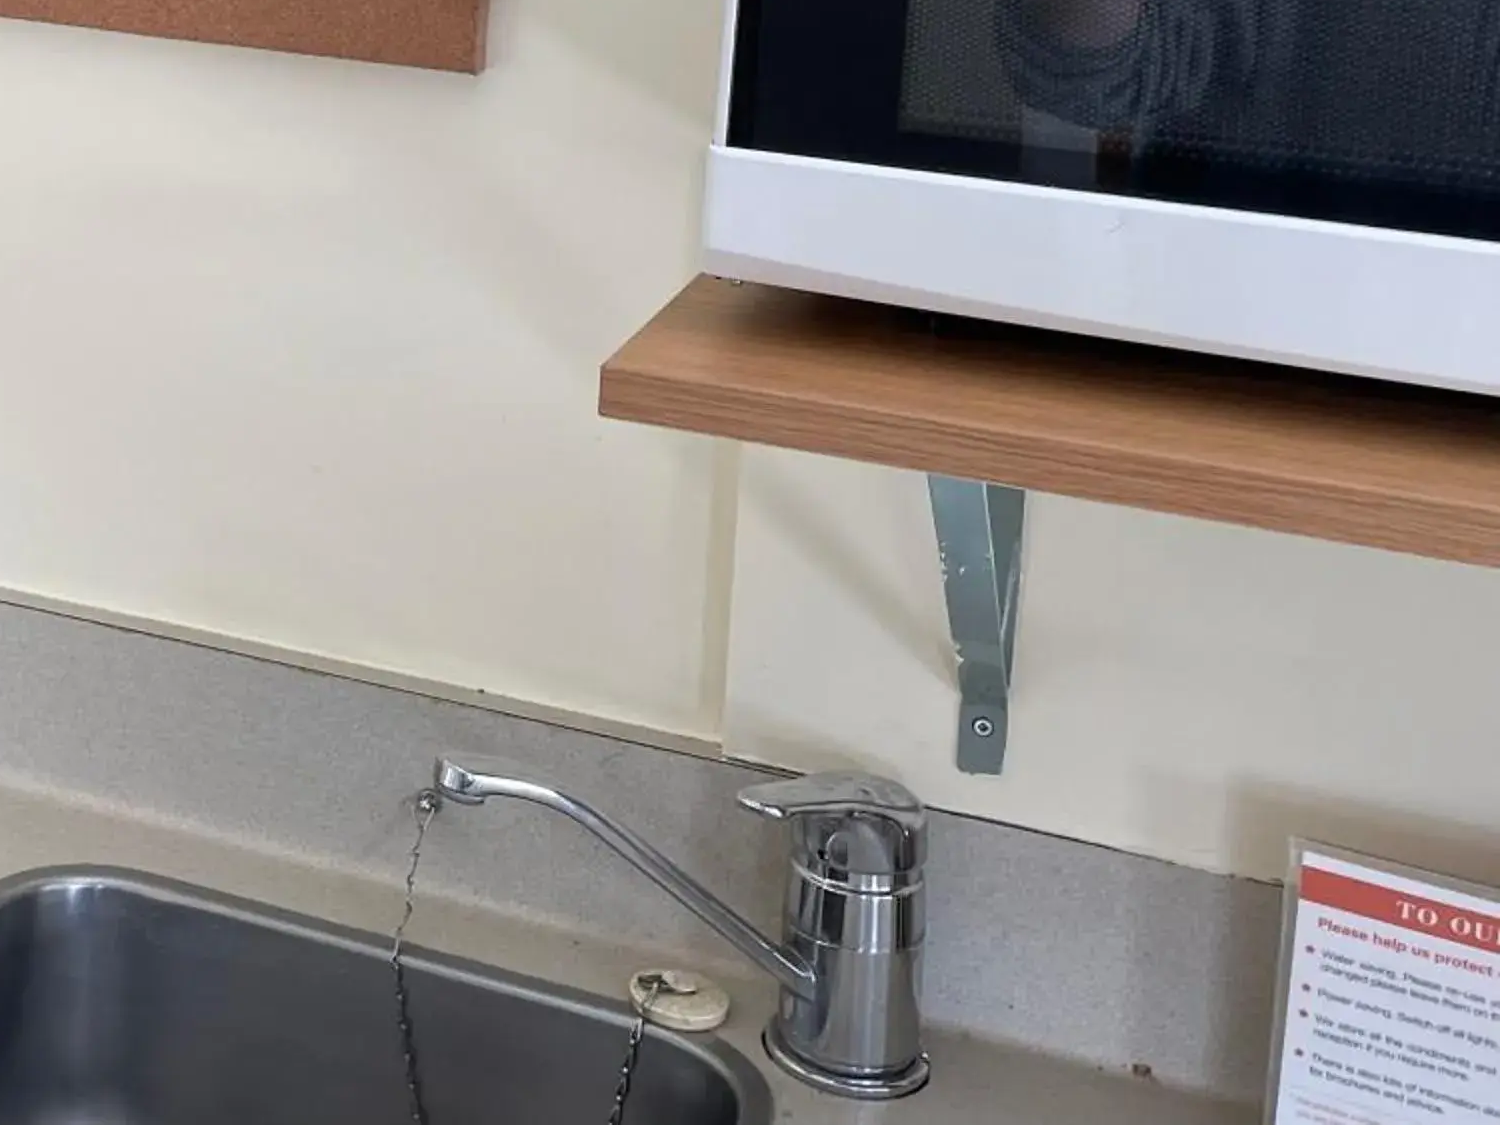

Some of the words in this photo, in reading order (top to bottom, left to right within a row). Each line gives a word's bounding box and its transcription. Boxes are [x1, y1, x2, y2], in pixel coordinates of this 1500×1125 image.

[1396, 900, 1439, 927] TO
[1318, 916, 1369, 942] Please
[1373, 931, 1408, 954] help
[1411, 945, 1430, 959] us
[1434, 952, 1494, 978] protect
[1320, 964, 1369, 984] changed
[1369, 978, 1407, 995] please
[1322, 948, 1355, 966] Water
[1403, 971, 1442, 992] Please
[1317, 987, 1353, 1006] Power
